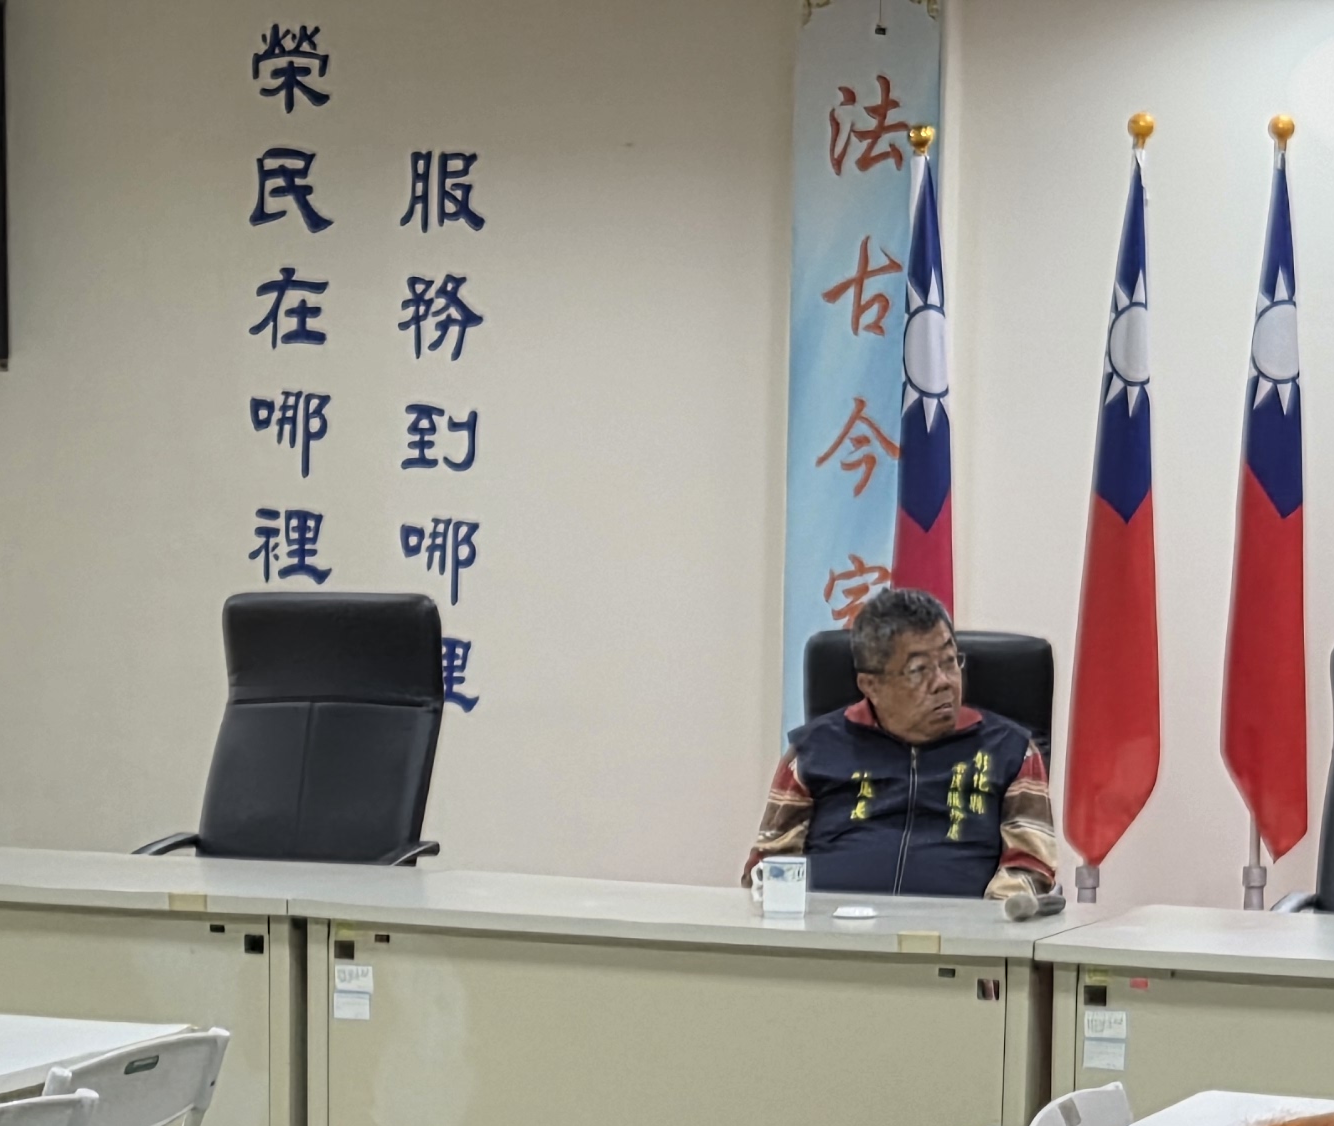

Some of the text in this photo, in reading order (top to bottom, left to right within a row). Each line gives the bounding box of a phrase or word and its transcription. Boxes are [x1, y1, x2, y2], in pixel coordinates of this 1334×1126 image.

[249, 23, 334, 586] 榮民在哪裡
